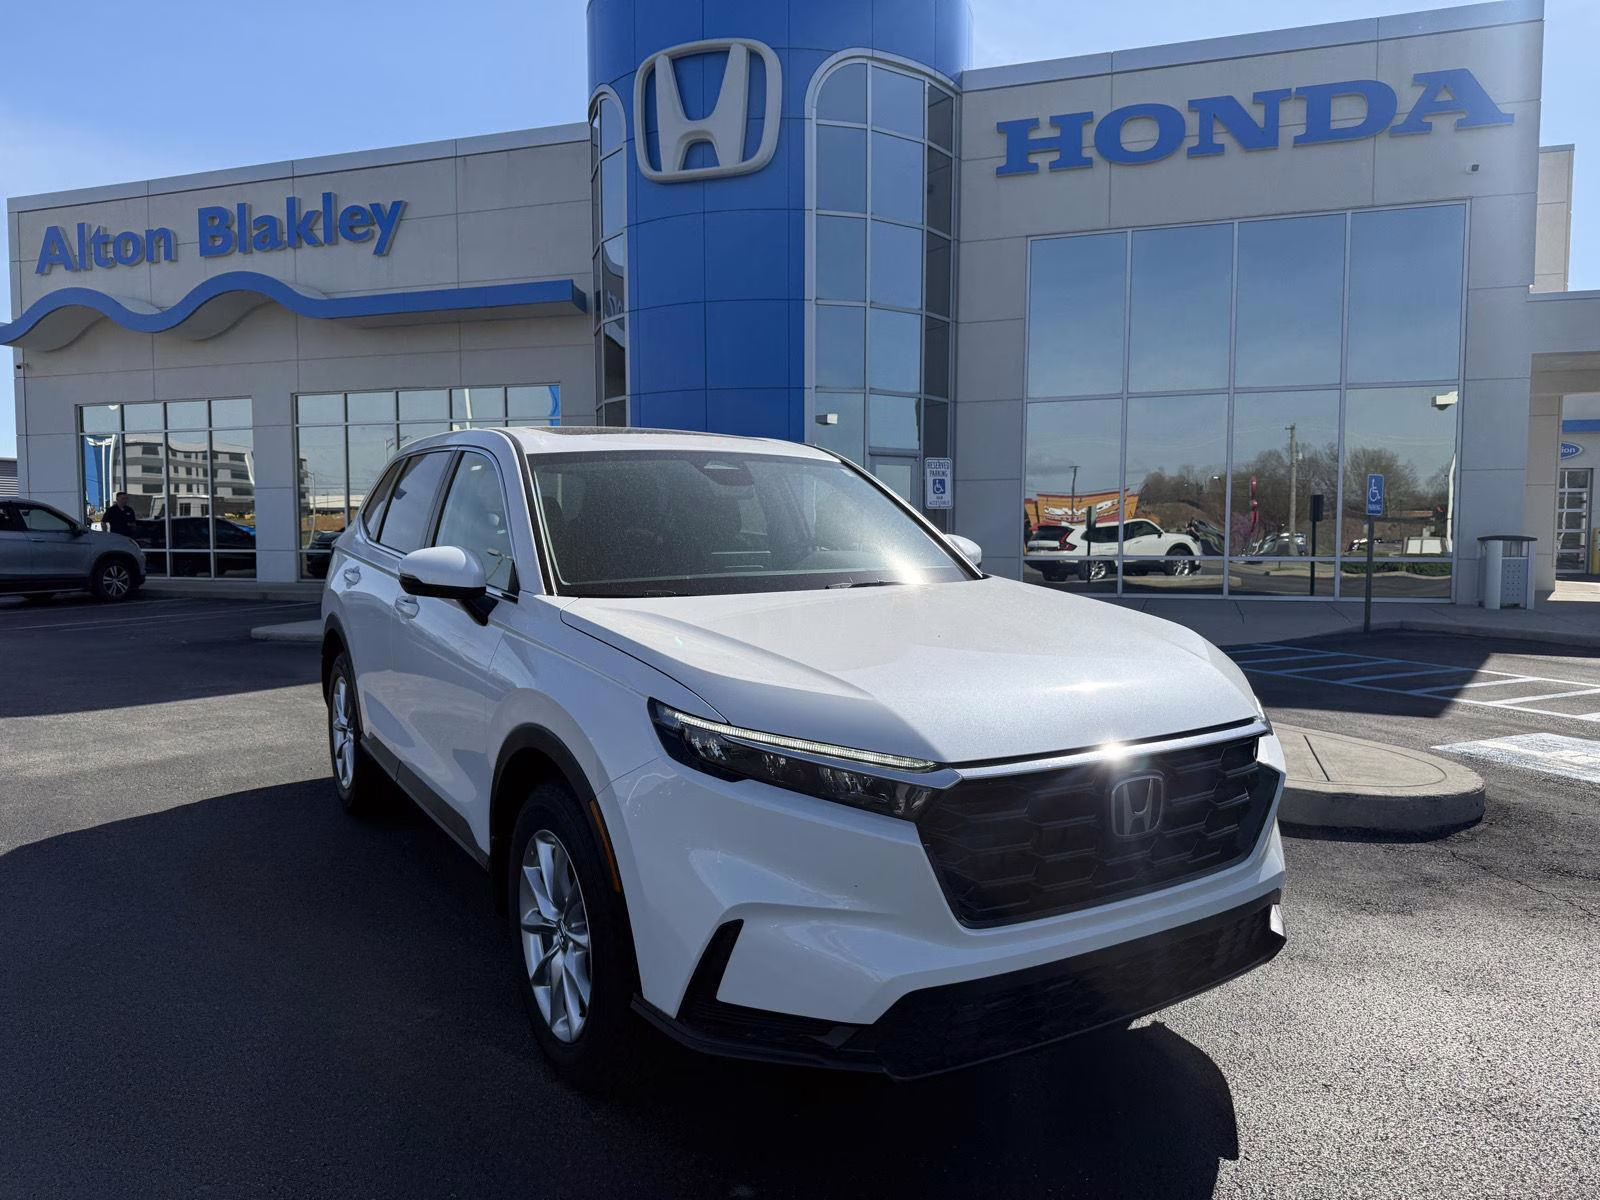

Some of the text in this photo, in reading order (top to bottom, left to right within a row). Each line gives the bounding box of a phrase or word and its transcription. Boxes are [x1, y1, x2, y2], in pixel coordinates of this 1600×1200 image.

[995, 68, 1515, 177] HONDA
[35, 192, 408, 276] Alton Blakley
[927, 462, 950, 470] RESERVED
